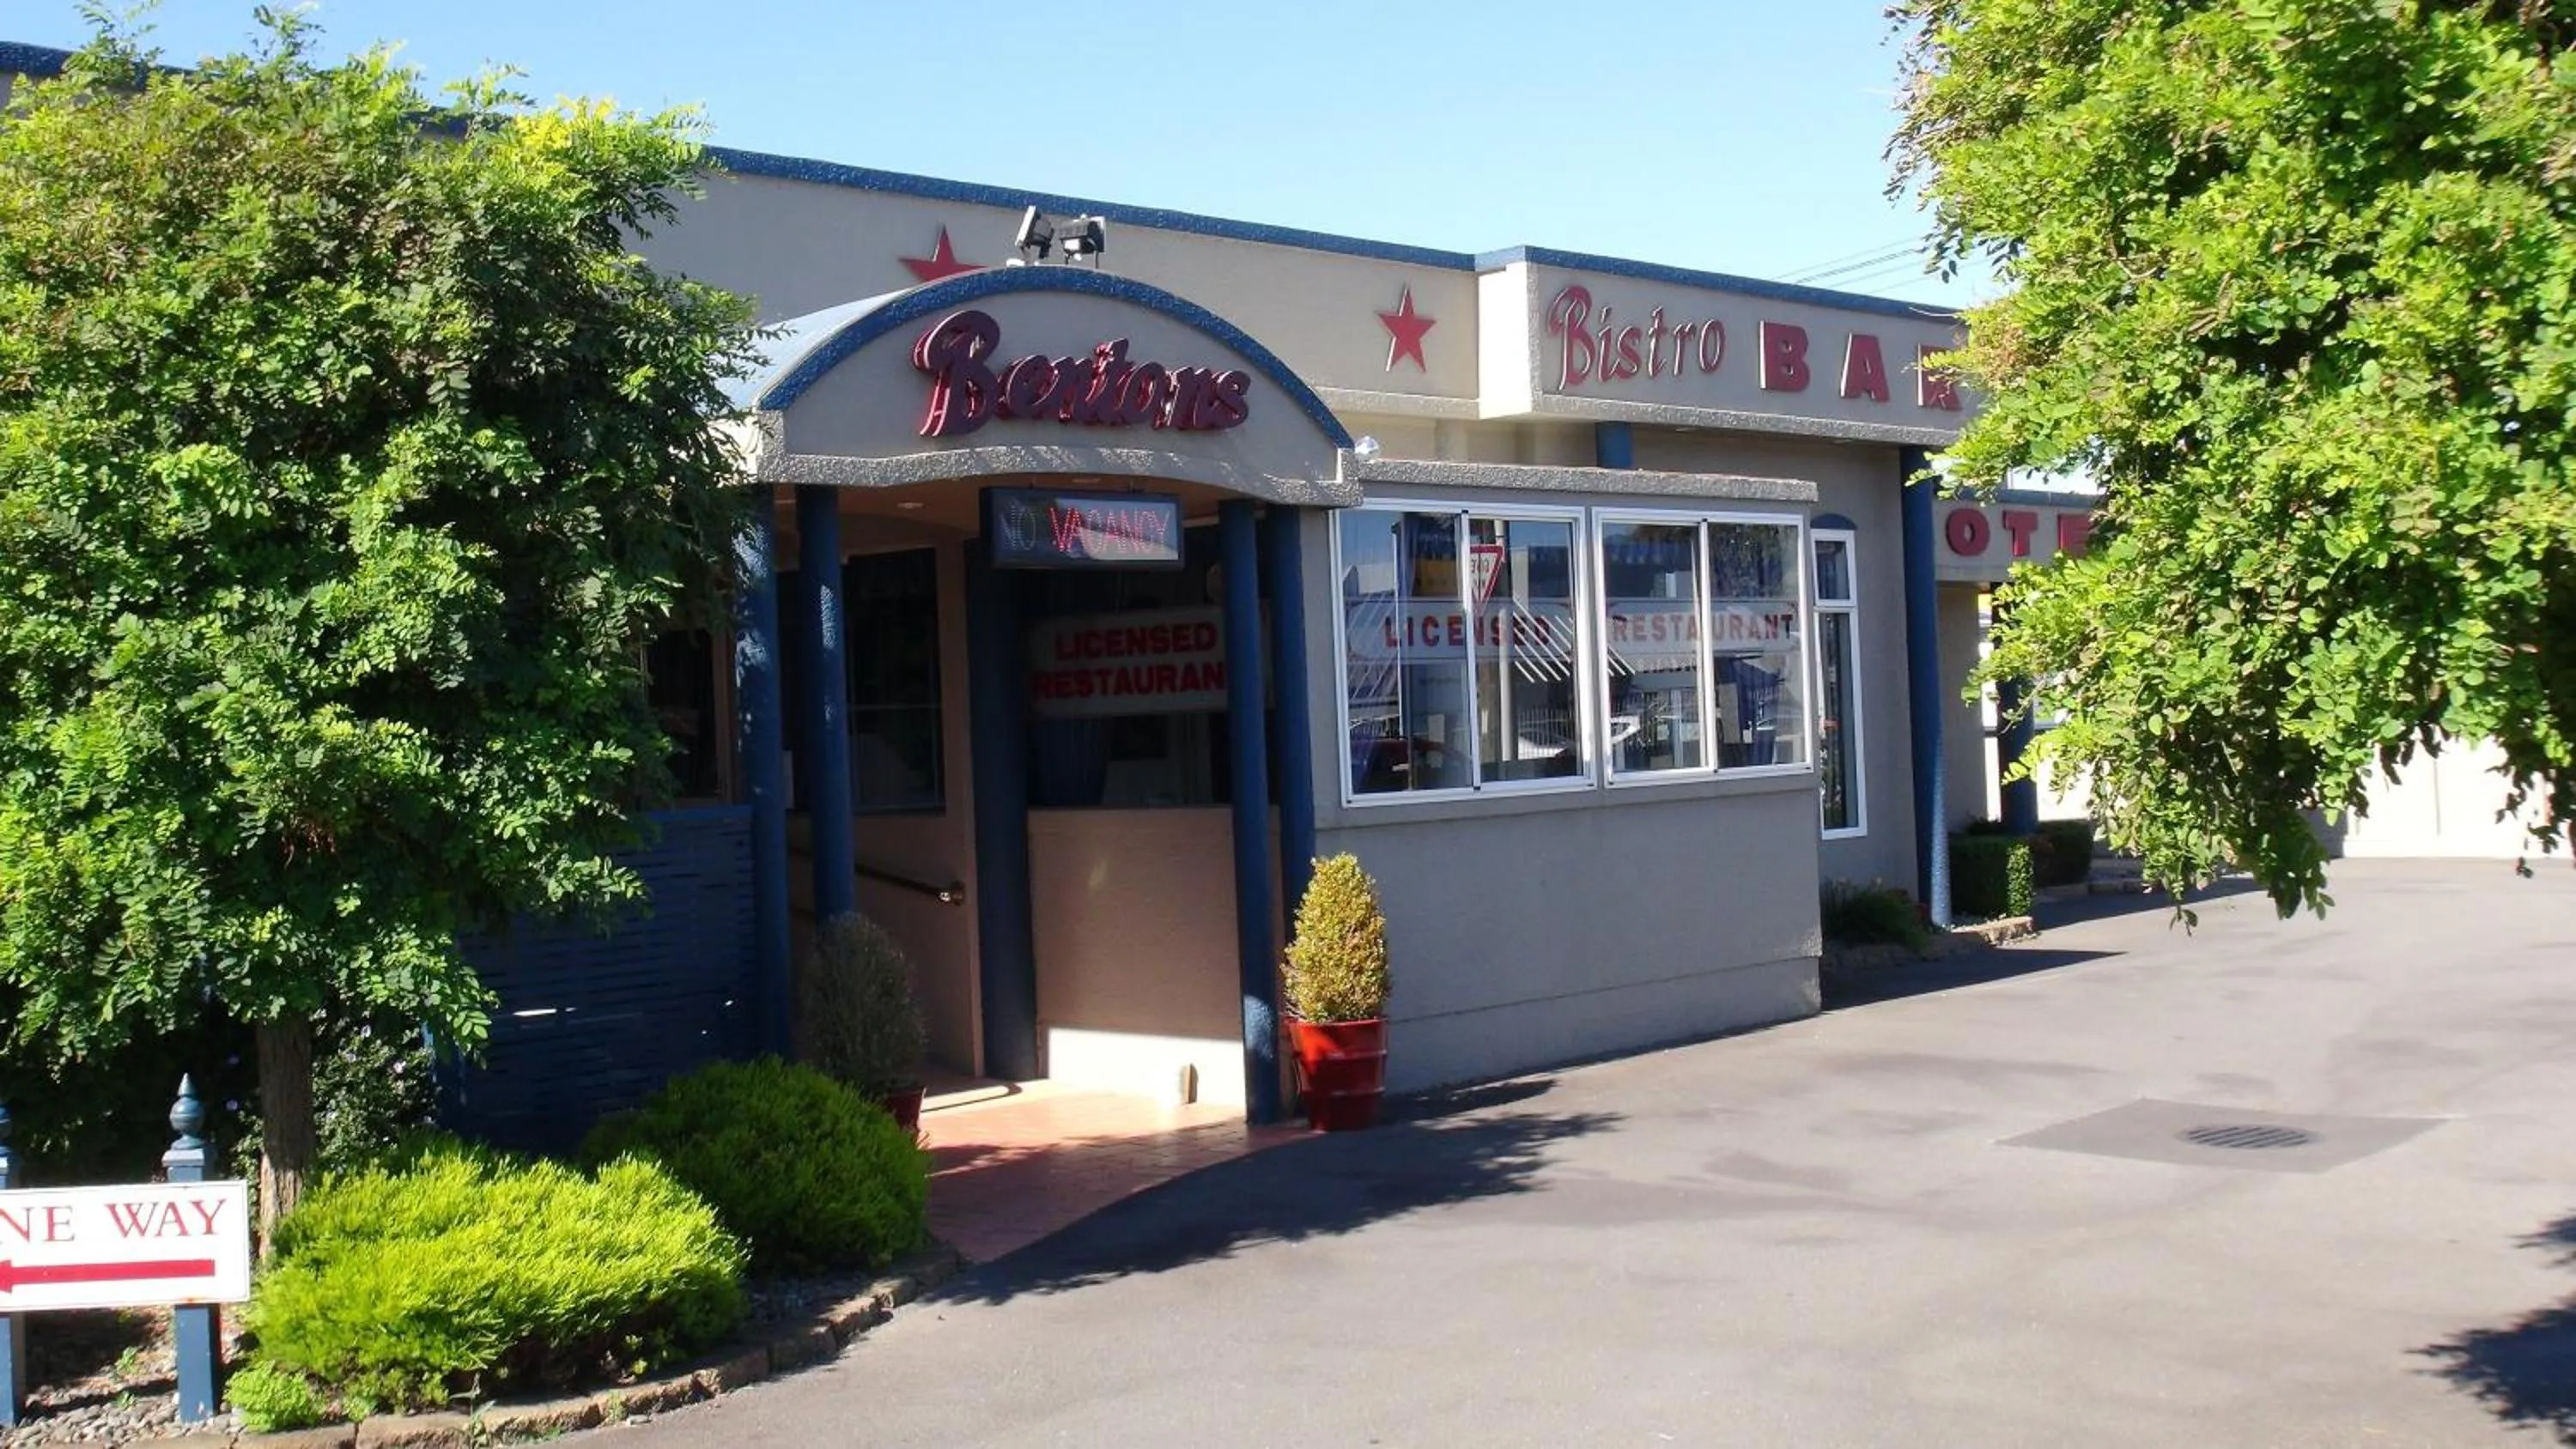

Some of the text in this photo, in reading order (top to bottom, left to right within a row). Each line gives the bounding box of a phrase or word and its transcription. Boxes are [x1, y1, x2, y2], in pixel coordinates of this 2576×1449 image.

[1548, 285, 1963, 411] Bistro BAR
[911, 310, 1251, 437] Bentons
[1001, 499, 1170, 554] NO VACANCY
[1946, 508, 2093, 558] OTE
[1055, 622, 1217, 661] LICENSED
[1385, 615, 1551, 647] LICENSED
[1030, 661, 1225, 700] RESTAURAN
[0, 1198, 227, 1243] NE WAY
